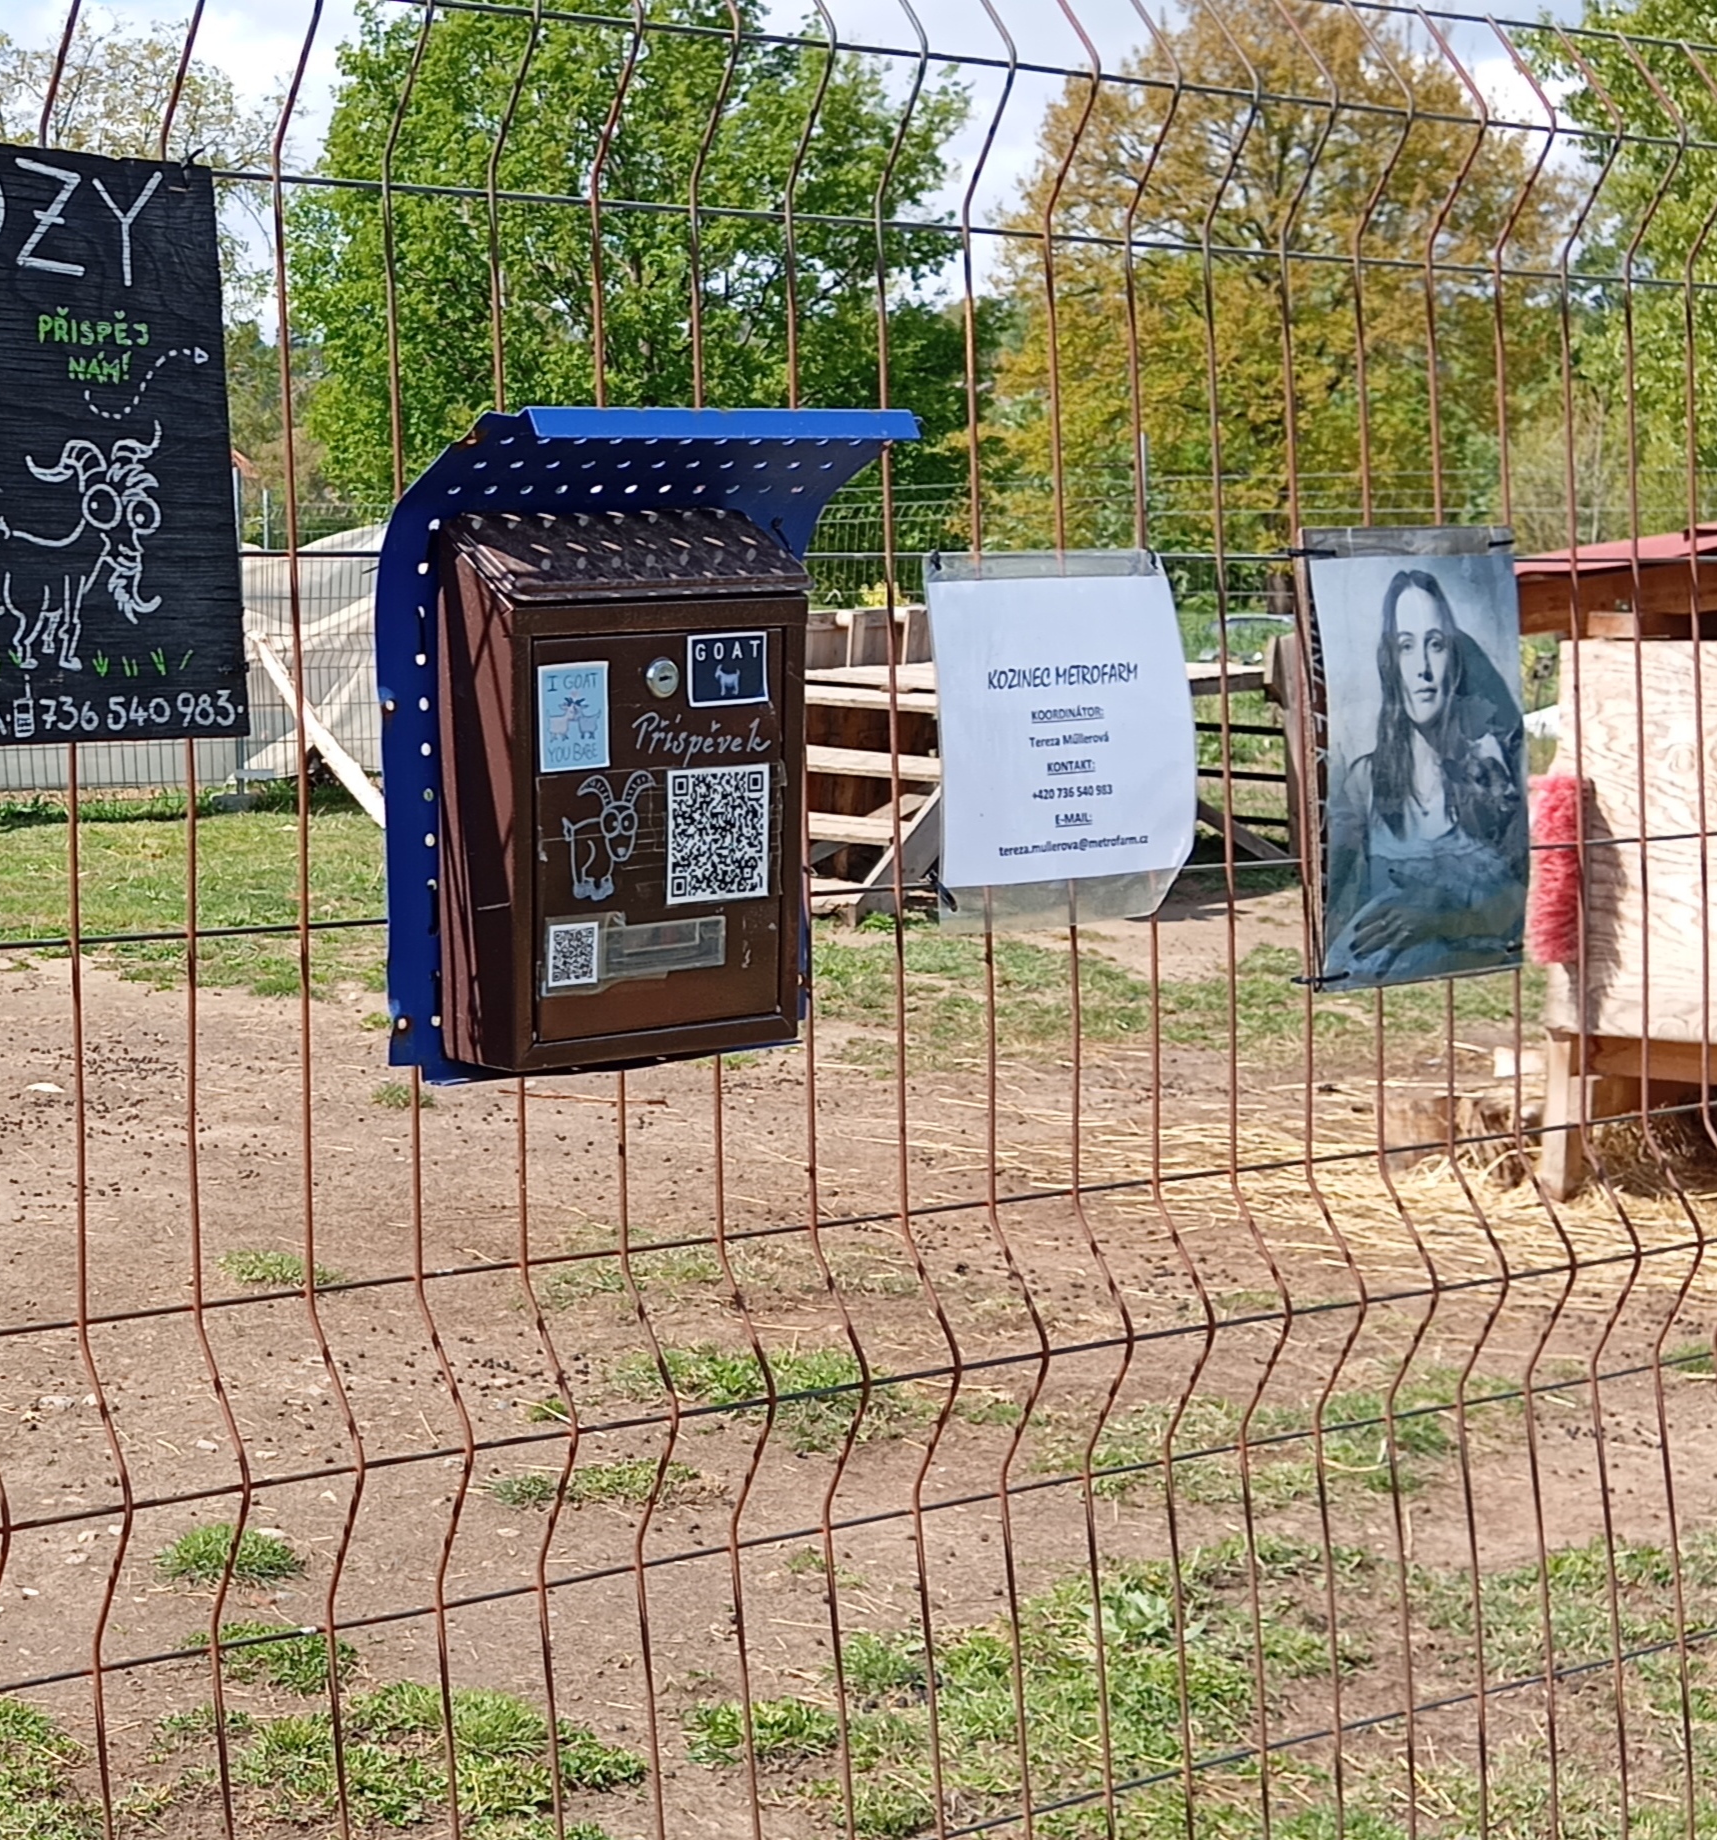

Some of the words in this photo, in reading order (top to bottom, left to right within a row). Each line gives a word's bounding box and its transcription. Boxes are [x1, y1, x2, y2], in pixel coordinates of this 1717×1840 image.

[38, 306, 150, 346] PŘISPĚJ
[68, 350, 132, 384] NÁM!
[694, 640, 761, 661] GOAT
[563, 672, 598, 690] GOAT
[987, 667, 1051, 690] KOZINEC
[1055, 661, 1138, 686] METROFARM
[39, 695, 100, 732] 736
[107, 695, 172, 731] 540
[176, 689, 236, 727] 983
[1031, 704, 1104, 724] KOORDINÁTOR:
[632, 711, 771, 767] Příspěvek
[1029, 736, 1060, 748] Tereza
[547, 746, 571, 762] YOU
[1047, 759, 1096, 776] KONTAKT:
[1033, 789, 1055, 800] +420
[1057, 786, 1074, 799] 736
[1076, 784, 1094, 798] 540
[1096, 783, 1113, 796] 983
[1055, 812, 1093, 828] E-MAIL:
[999, 834, 1149, 857] tereza.mullerova@metrofarm.cz
